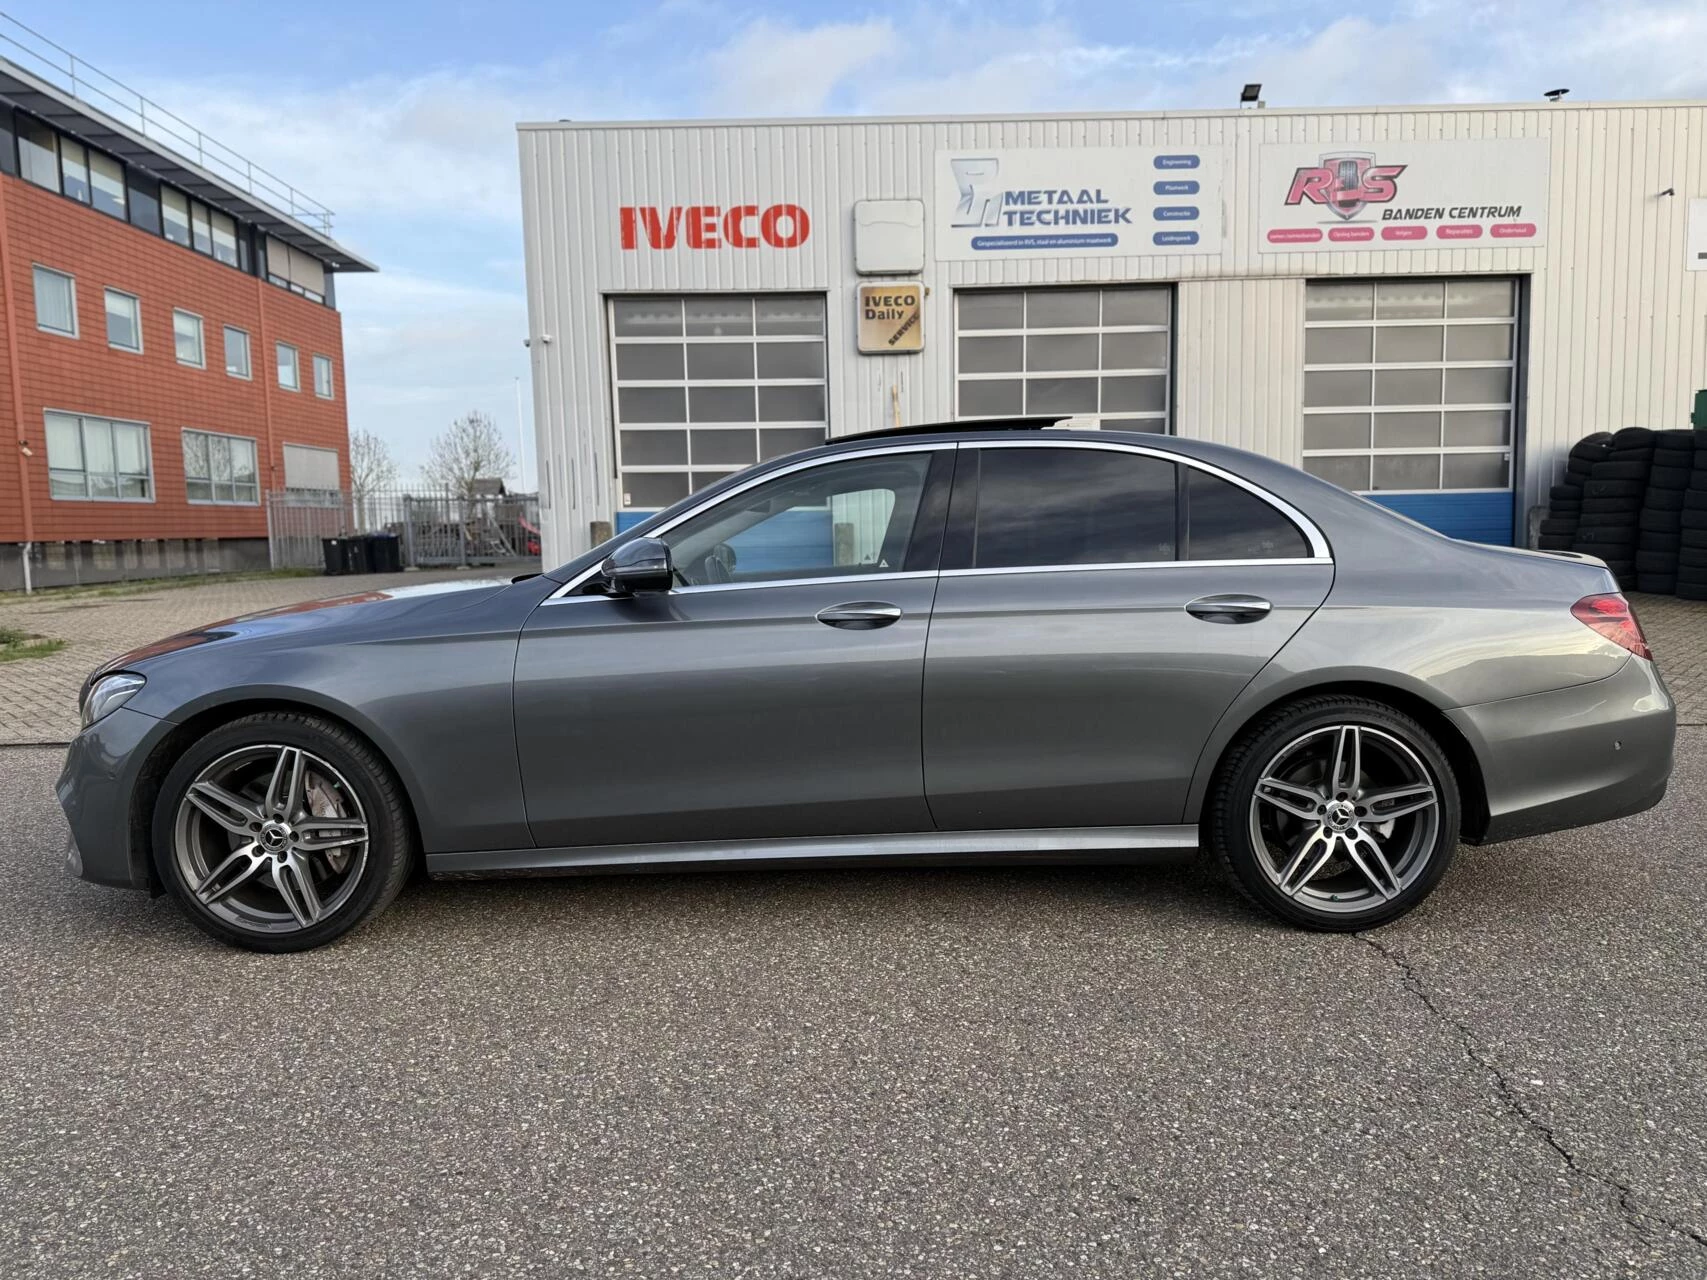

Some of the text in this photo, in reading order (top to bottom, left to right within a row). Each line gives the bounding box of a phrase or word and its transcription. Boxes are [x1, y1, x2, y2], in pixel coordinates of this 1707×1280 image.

[1004, 189, 1109, 206] METAAL
[1003, 208, 1133, 227] TECHNIEK
[1382, 205, 1522, 221] BANDEN CENTRUM
[619, 203, 810, 250] IVECO
[865, 295, 916, 307] IVECO
[865, 308, 904, 320] Daily
